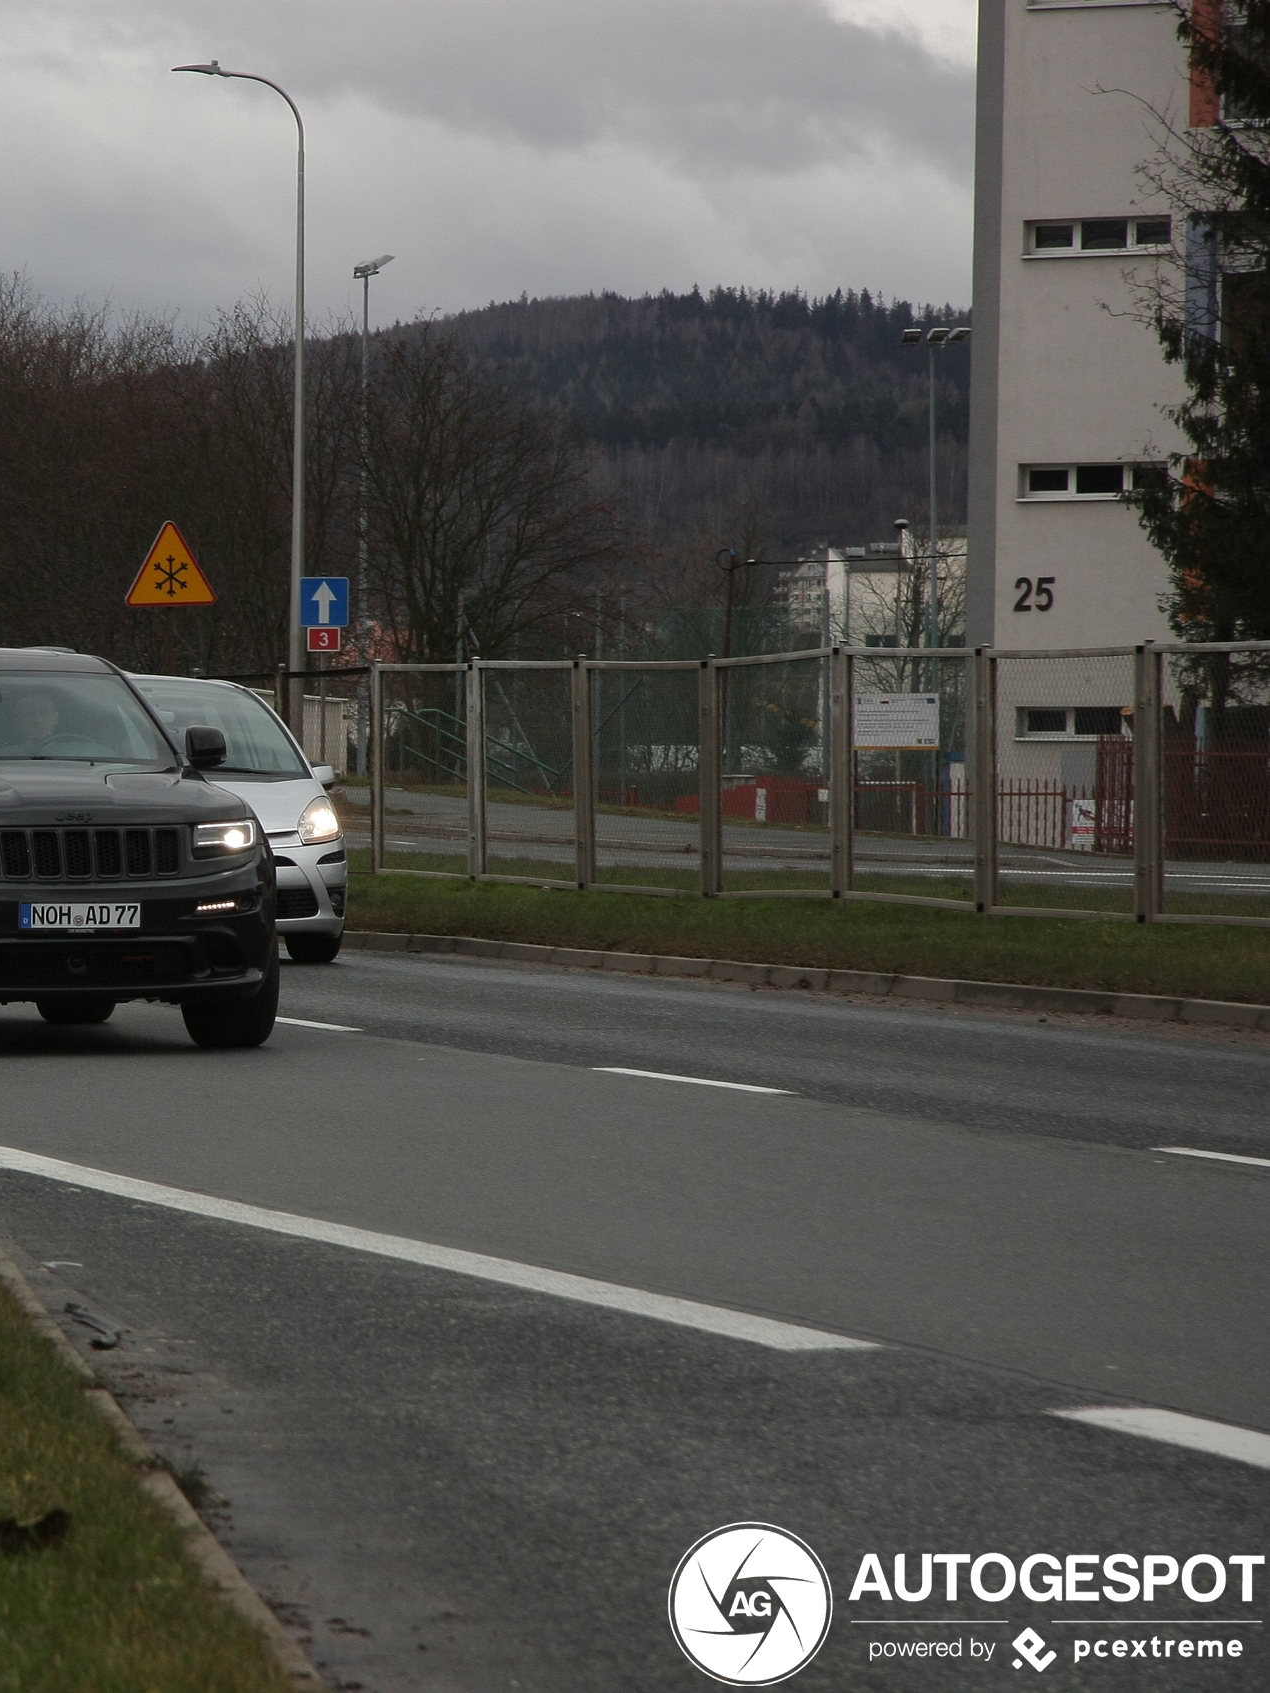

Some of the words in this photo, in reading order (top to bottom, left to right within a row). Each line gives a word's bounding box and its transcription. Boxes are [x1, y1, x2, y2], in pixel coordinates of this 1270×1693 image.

[1013, 577, 1056, 612] 25
[318, 632, 329, 647] 3
[54, 810, 93, 824] Jeep
[32, 905, 71, 925] NOH
